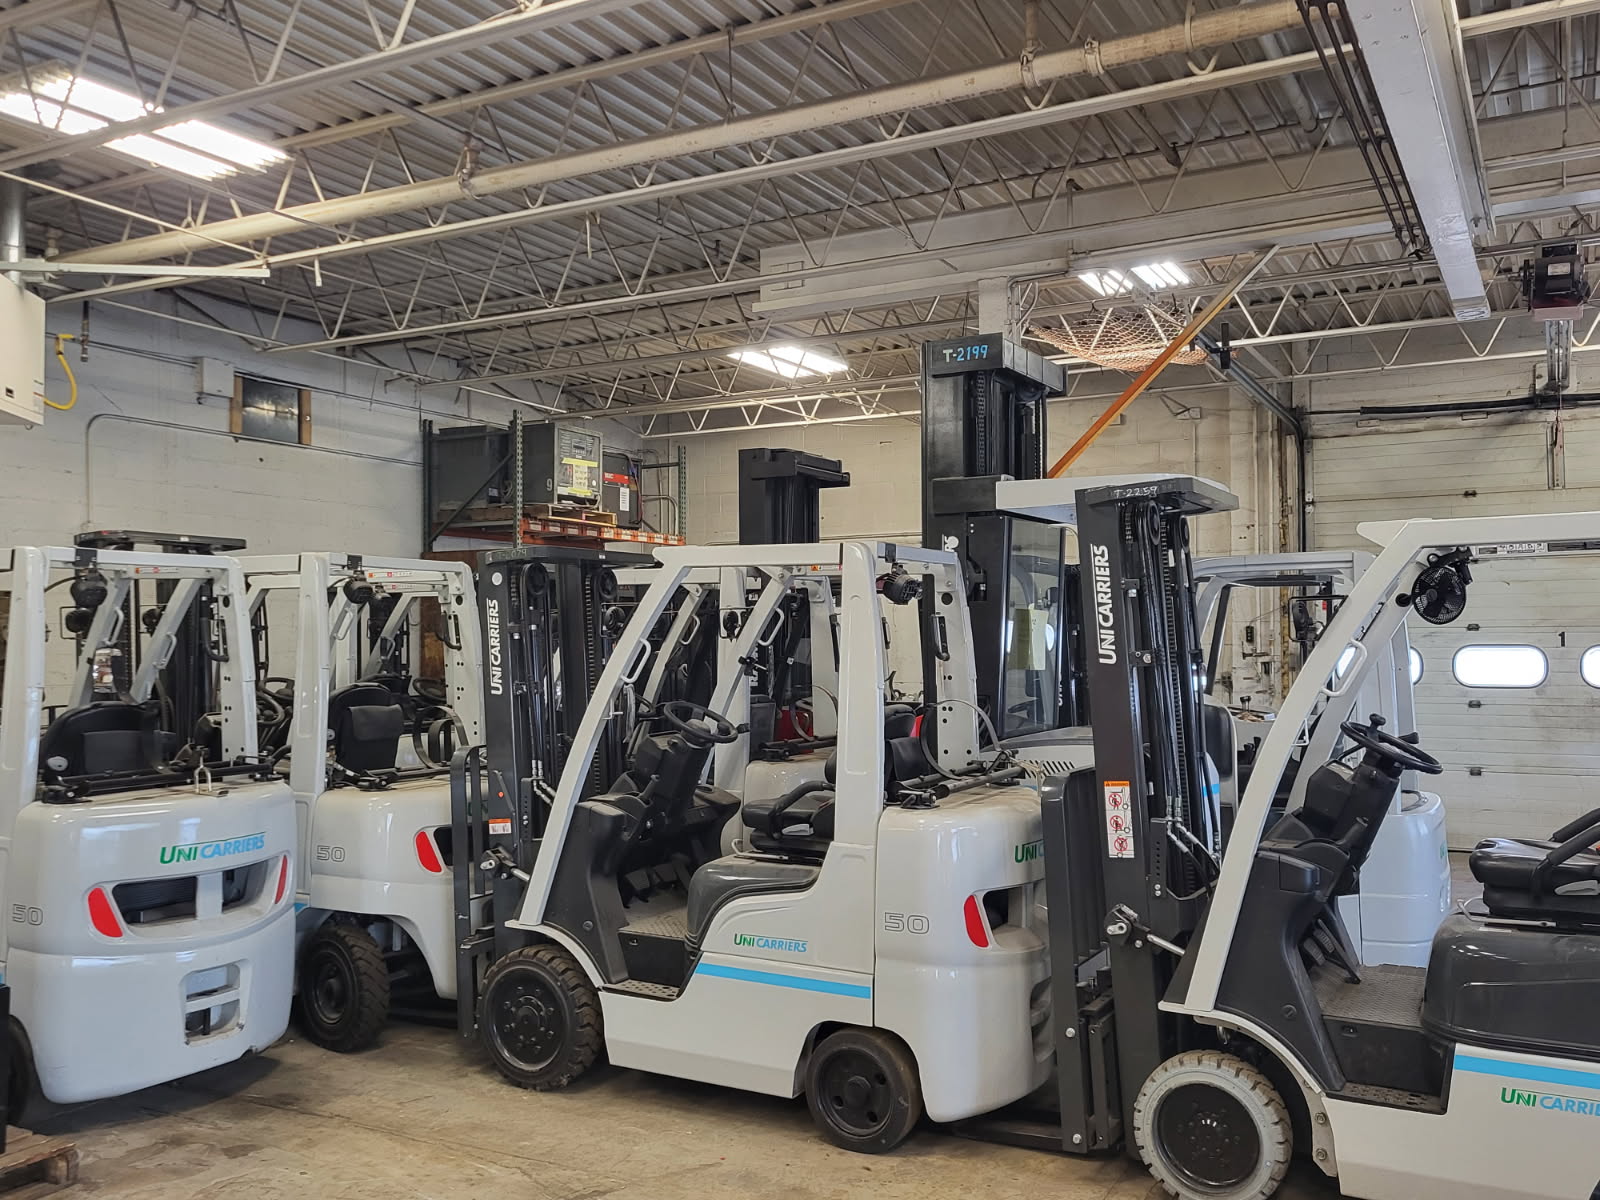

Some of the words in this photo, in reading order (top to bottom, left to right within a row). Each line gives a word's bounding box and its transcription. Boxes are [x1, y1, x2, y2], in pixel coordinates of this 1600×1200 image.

[943, 344, 988, 363] T-2199
[1558, 631, 1566, 647] 1
[316, 844, 346, 862] 50
[12, 903, 44, 926] 50
[884, 911, 930, 935] 50
